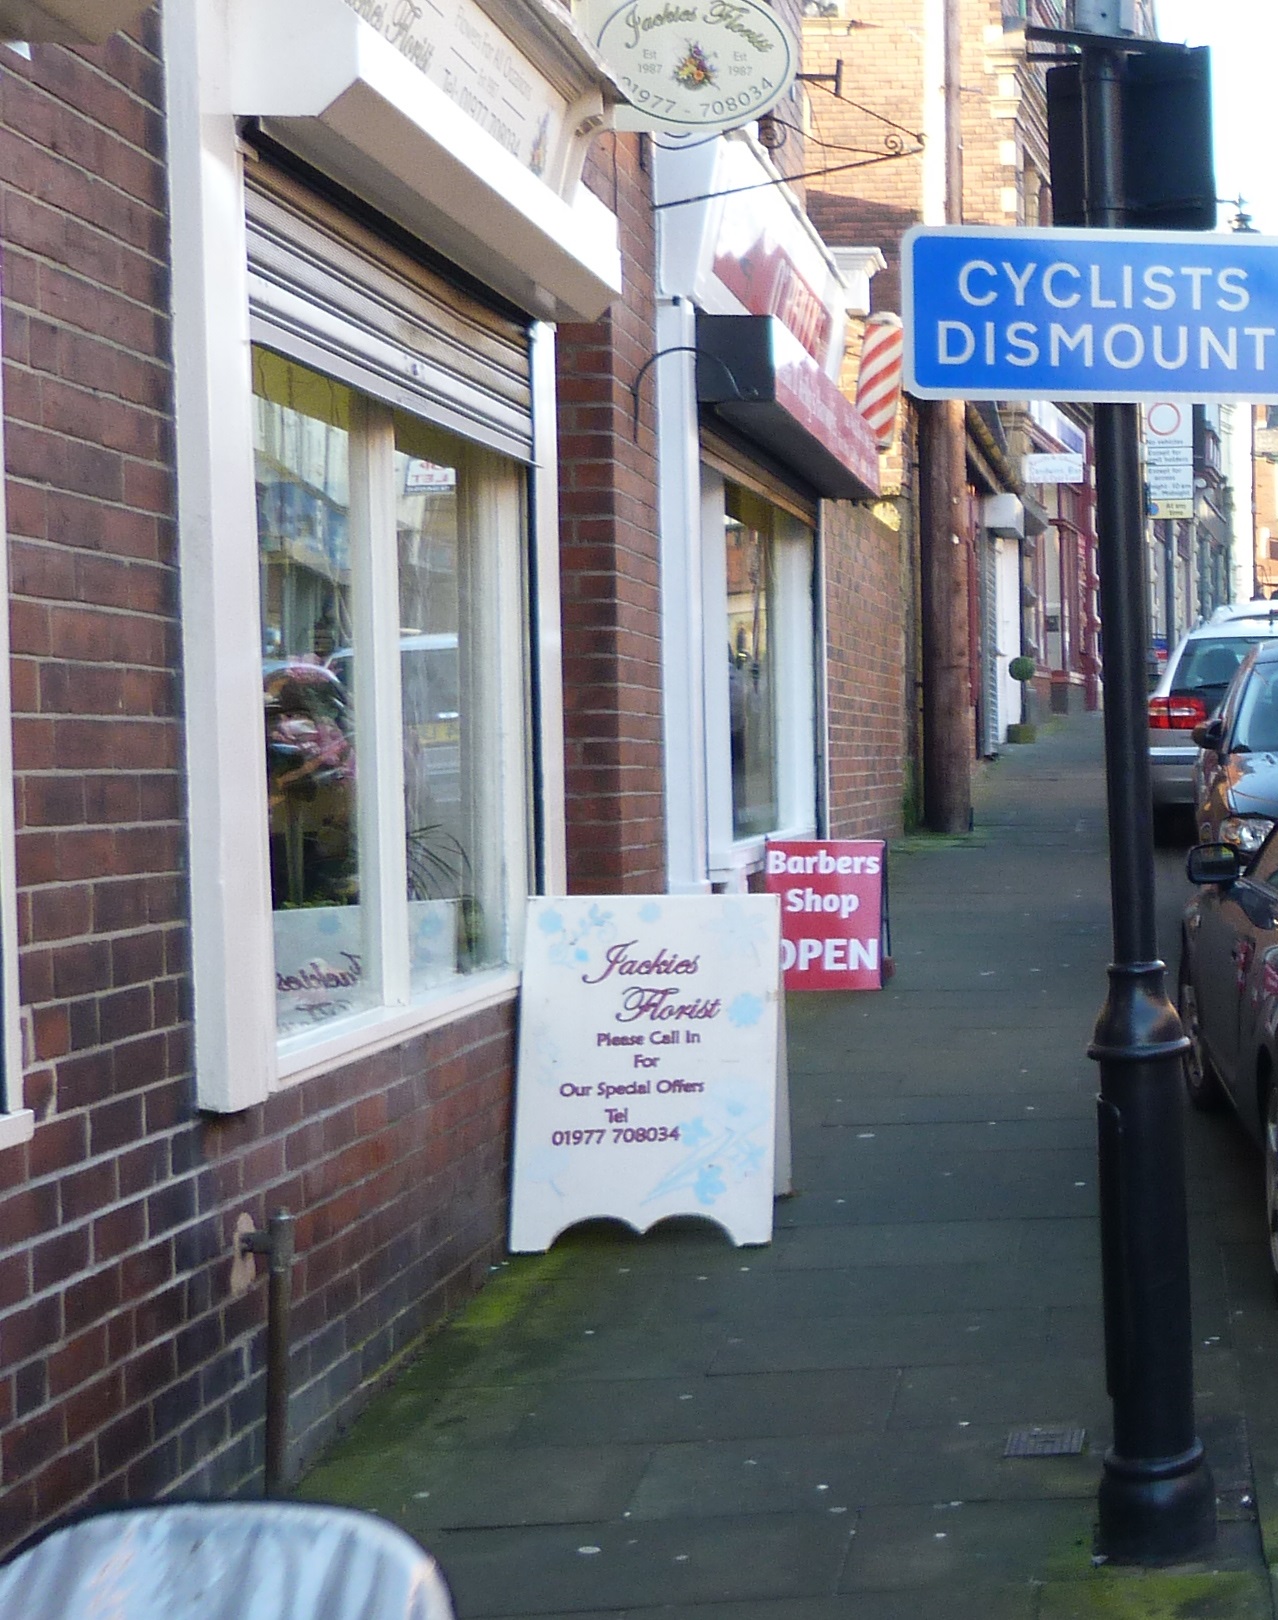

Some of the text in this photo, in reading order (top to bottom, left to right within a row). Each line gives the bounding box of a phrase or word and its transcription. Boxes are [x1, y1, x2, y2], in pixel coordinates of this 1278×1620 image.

[625, 0, 774, 53] Jackies Florist
[643, 49, 658, 61] Est
[733, 51, 748, 62] Est
[637, 62, 663, 75] 1987
[727, 65, 753, 77] 1987
[699, 76, 774, 118] 708034
[958, 259, 1250, 312] CYCLISTS
[937, 320, 1276, 371] DISMOUNT
[767, 850, 881, 874] Barbers
[785, 887, 860, 919] Shop
[582, 939, 700, 985] Jackies
[779, 937, 879, 972] OPEN
[615, 986, 722, 1023] Florist
[597, 1030, 701, 1047] Please Call In
[633, 1054, 661, 1069] For
[559, 1079, 705, 1099] Our Special Offers
[604, 1107, 629, 1124] Tel
[551, 1125, 681, 1147] 01977 708034
